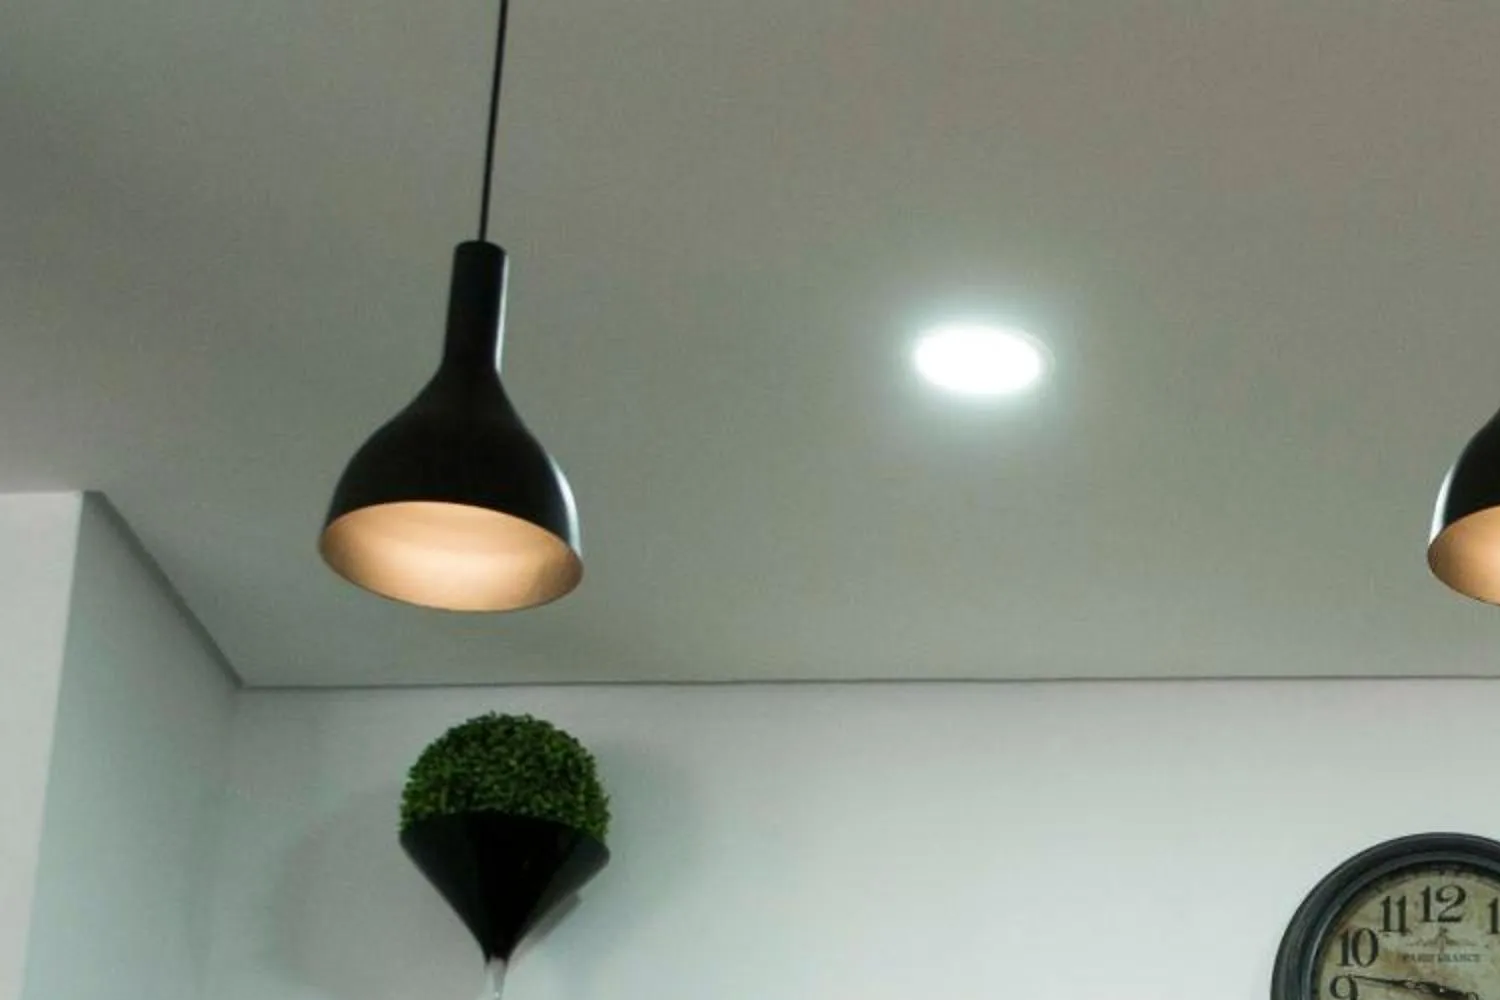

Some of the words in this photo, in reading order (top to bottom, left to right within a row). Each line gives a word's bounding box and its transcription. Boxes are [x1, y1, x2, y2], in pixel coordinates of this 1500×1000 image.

[1380, 896, 1410, 936] 11
[1420, 885, 1466, 923] 12
[1337, 927, 1379, 968] 10
